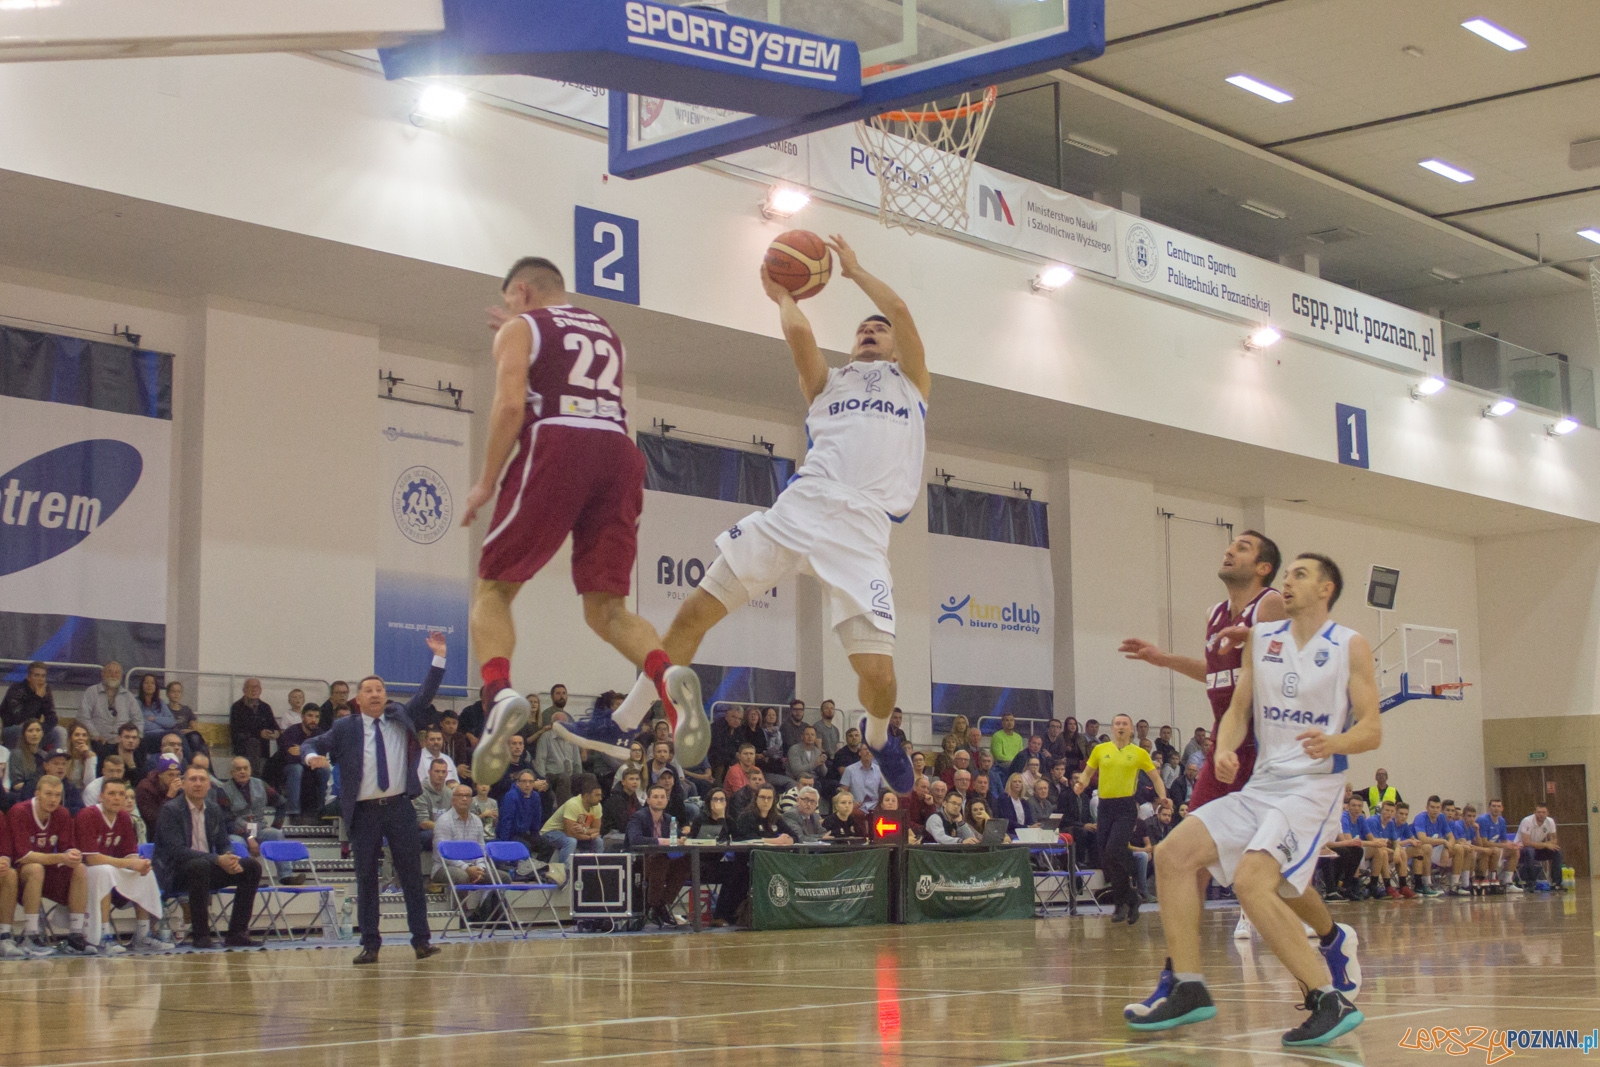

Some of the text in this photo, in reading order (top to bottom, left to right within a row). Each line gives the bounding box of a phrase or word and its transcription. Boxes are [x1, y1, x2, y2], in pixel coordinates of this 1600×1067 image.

[1027, 200, 1098, 232] Ministerstwo Nauki
[1031, 217, 1076, 243] Szkolnictwa
[1076, 229, 1111, 253] Wyższego
[592, 221, 625, 293] 2
[1166, 240, 1206, 269] Centrum
[1207, 254, 1236, 279] Sportu
[1167, 266, 1271, 316] Politechniki Poznańskiej
[1291, 292, 1436, 362] cspp.put.poznan.pl
[562, 332, 621, 398] 22
[863, 369, 881, 393] 2
[828, 397, 909, 420] BIOFARM
[1346, 413, 1360, 461] 1
[869, 579, 890, 611] 2
[968, 597, 1041, 625] funclub
[969, 619, 1040, 635] biuro podróży
[1281, 671, 1300, 698] 8
